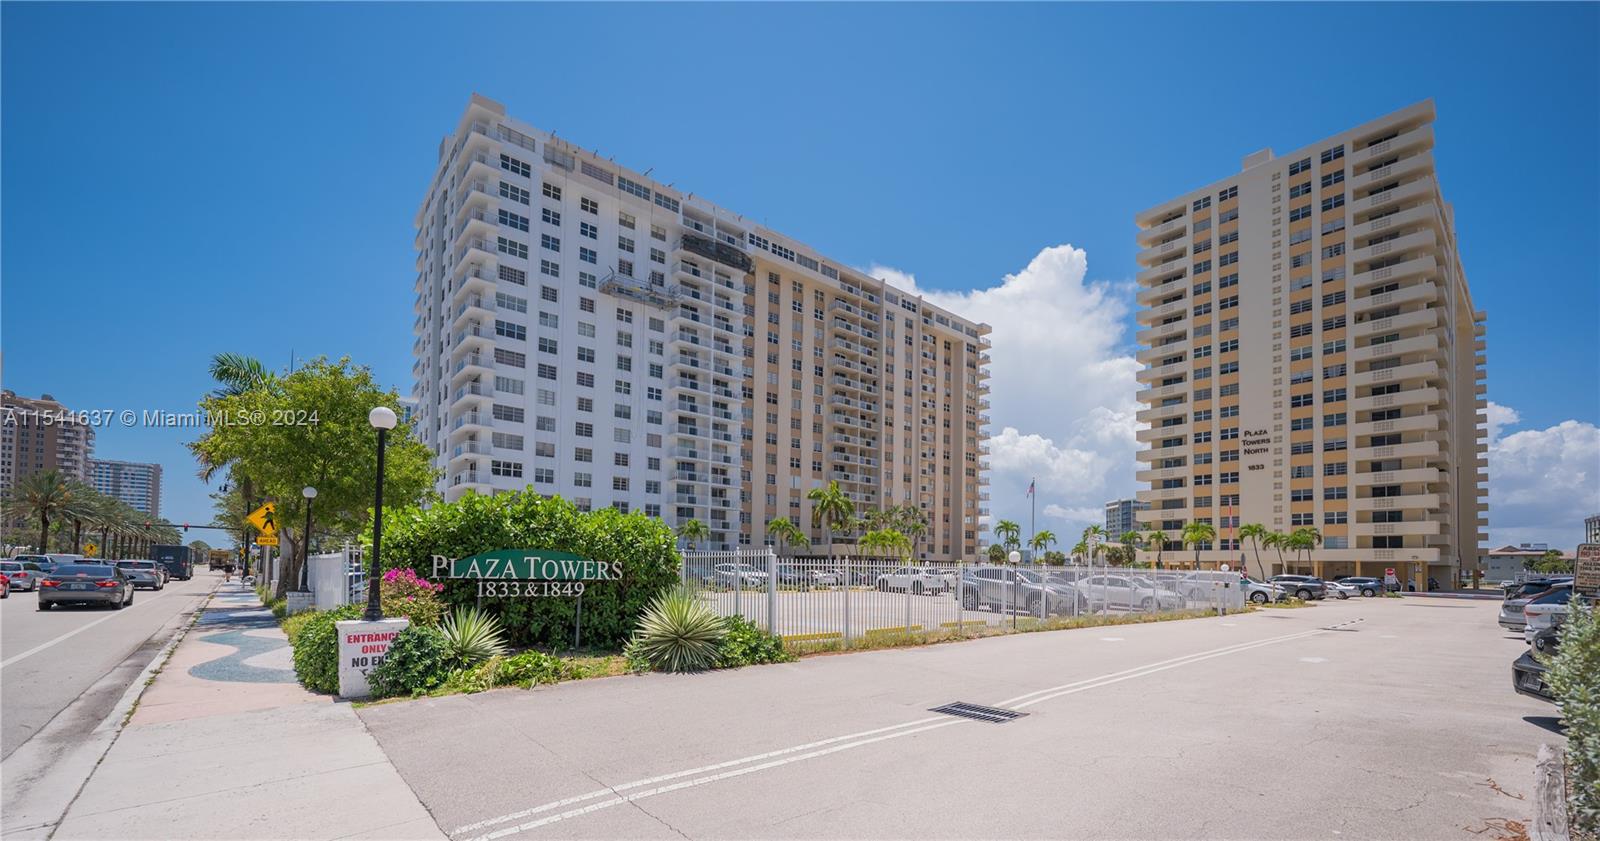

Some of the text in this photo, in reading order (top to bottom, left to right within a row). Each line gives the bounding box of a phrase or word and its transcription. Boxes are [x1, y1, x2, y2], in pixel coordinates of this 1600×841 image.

[1241, 438, 1271, 446] TOWERS
[430, 554, 624, 581] PLAZA TOWERS
[362, 644, 387, 654] ONLY
[351, 655, 385, 668] NO EX
